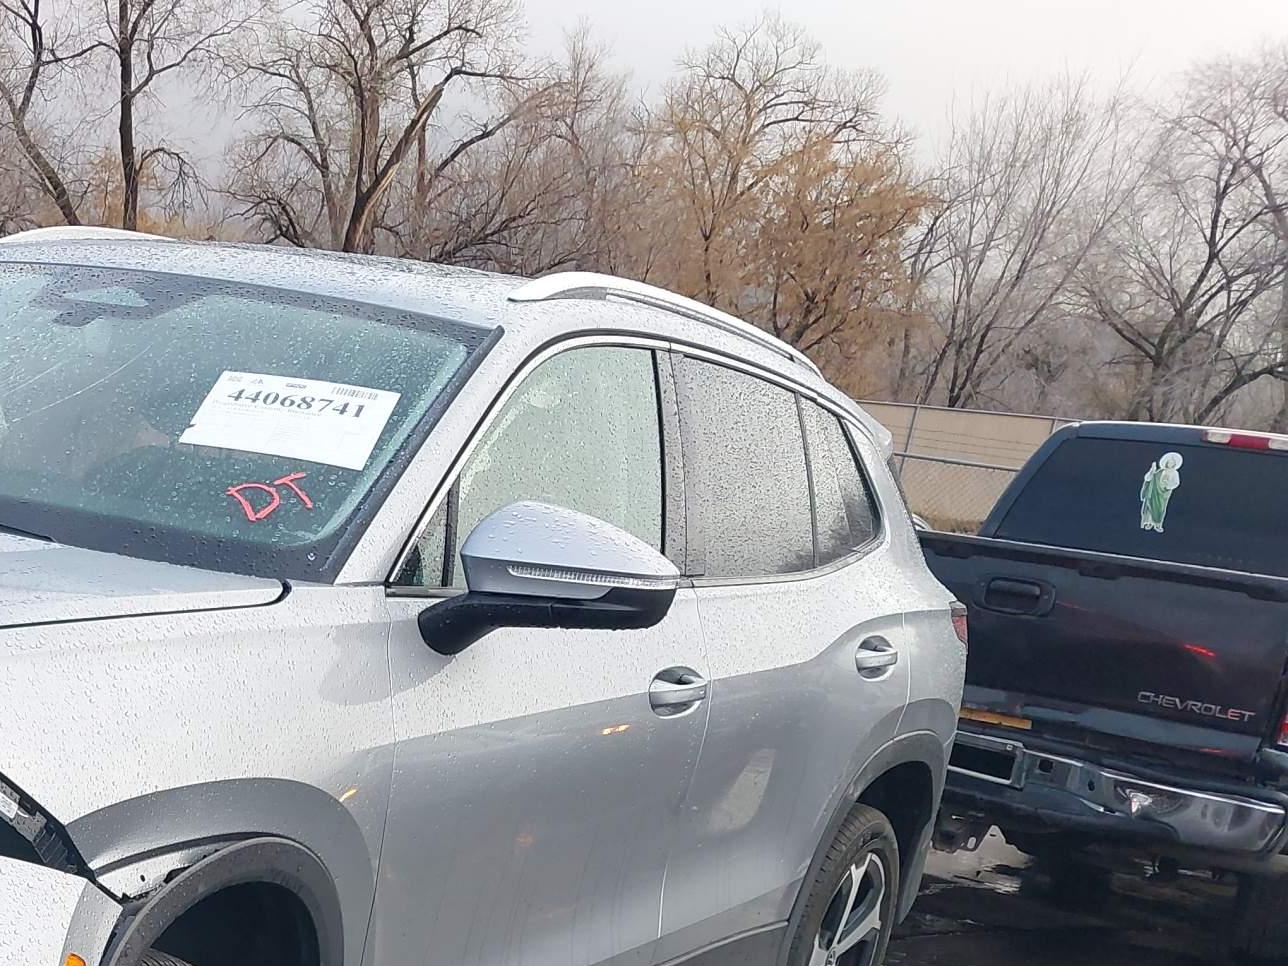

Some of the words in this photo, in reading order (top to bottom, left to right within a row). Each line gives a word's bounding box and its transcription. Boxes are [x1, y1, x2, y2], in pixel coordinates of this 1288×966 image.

[226, 388, 367, 418] 44068741
[224, 471, 313, 522] DT
[1137, 690, 1257, 723] CHEVROLET
